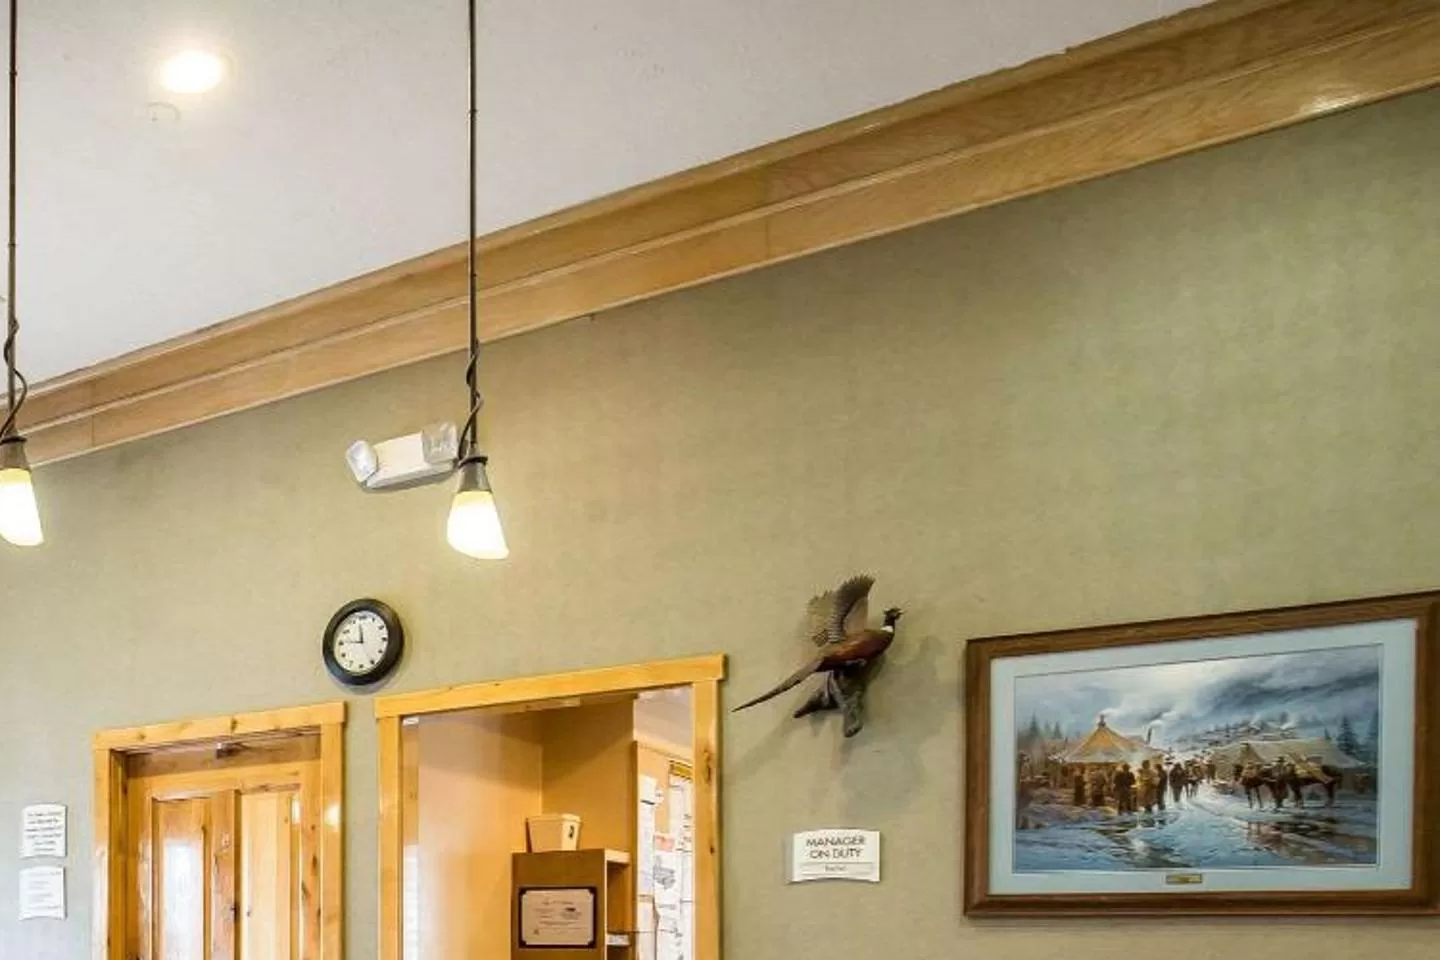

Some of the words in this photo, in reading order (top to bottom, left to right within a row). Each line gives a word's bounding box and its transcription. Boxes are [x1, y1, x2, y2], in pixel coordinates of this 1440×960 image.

[806, 835, 866, 847] MANAGER
[810, 849, 830, 859] ON
[833, 847, 863, 859] DUTY
